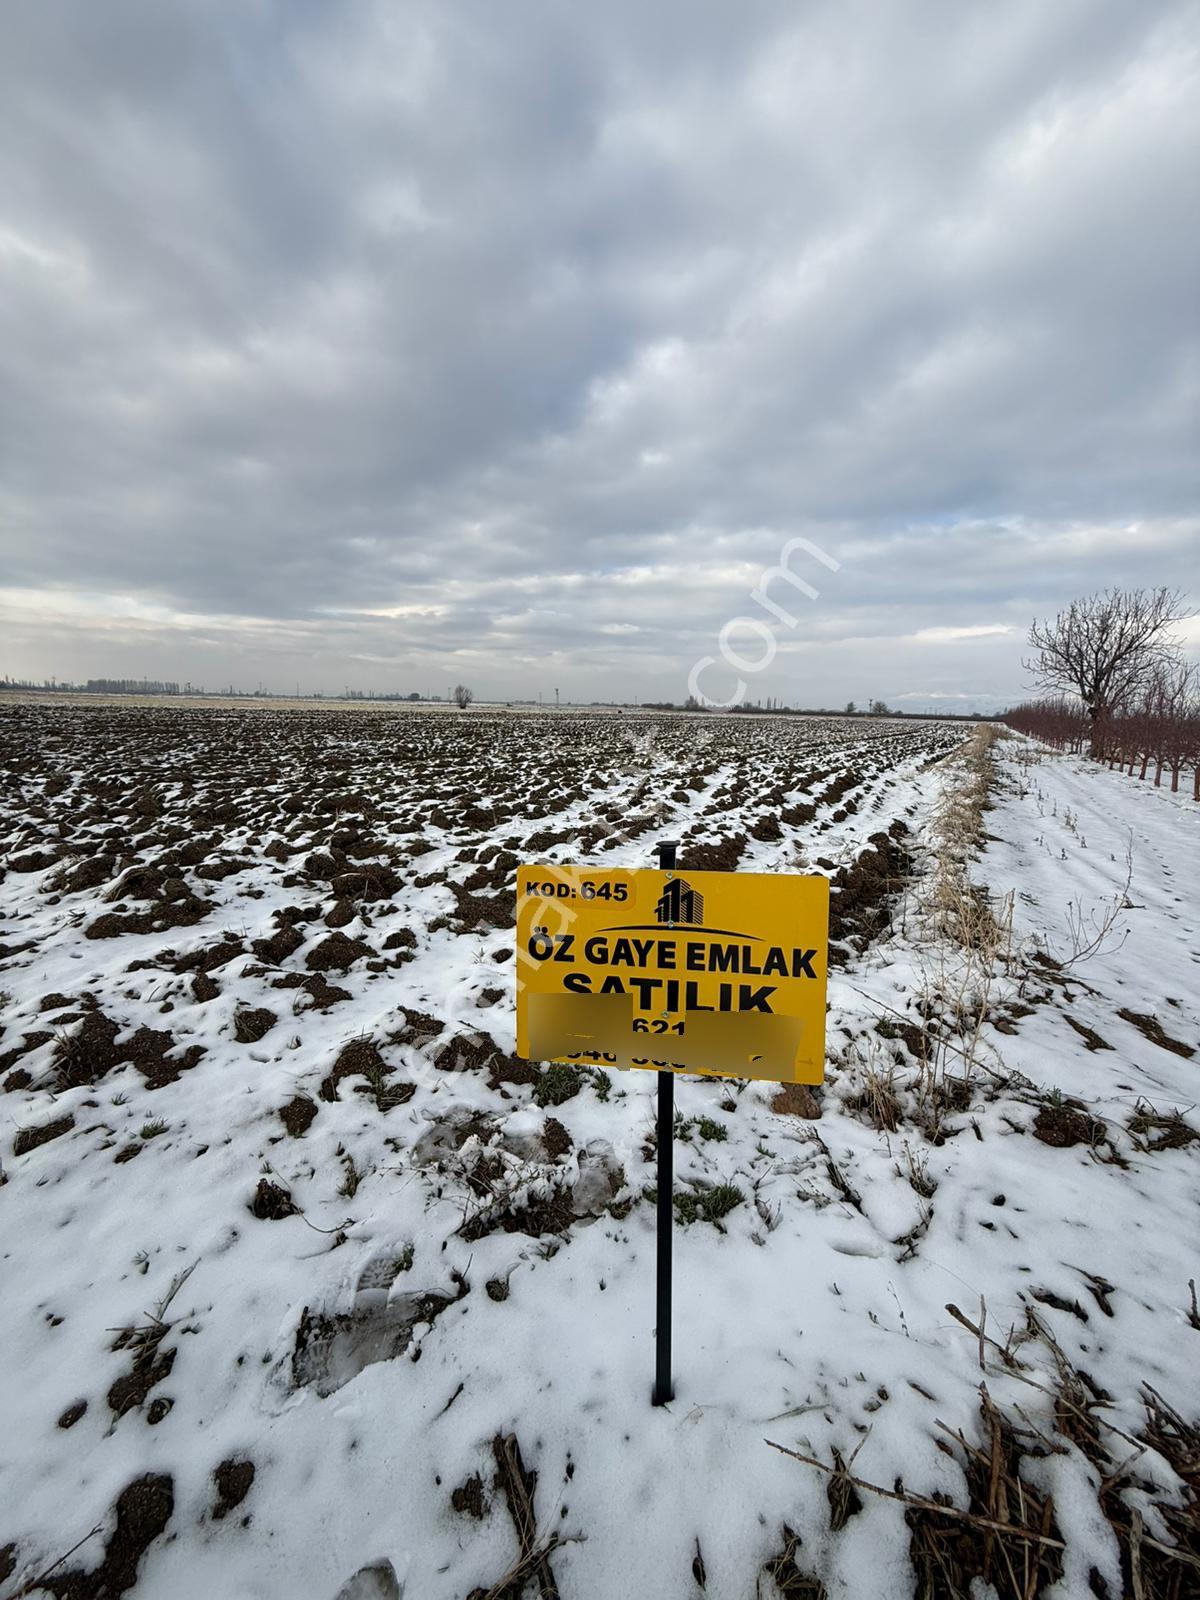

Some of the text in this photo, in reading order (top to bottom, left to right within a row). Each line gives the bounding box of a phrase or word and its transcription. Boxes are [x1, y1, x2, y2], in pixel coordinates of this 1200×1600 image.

[526, 881, 628, 902] KOD: 645
[528, 926, 818, 979] ÖZ GAYE EMLAK
[563, 973, 778, 1013] SATILIK
